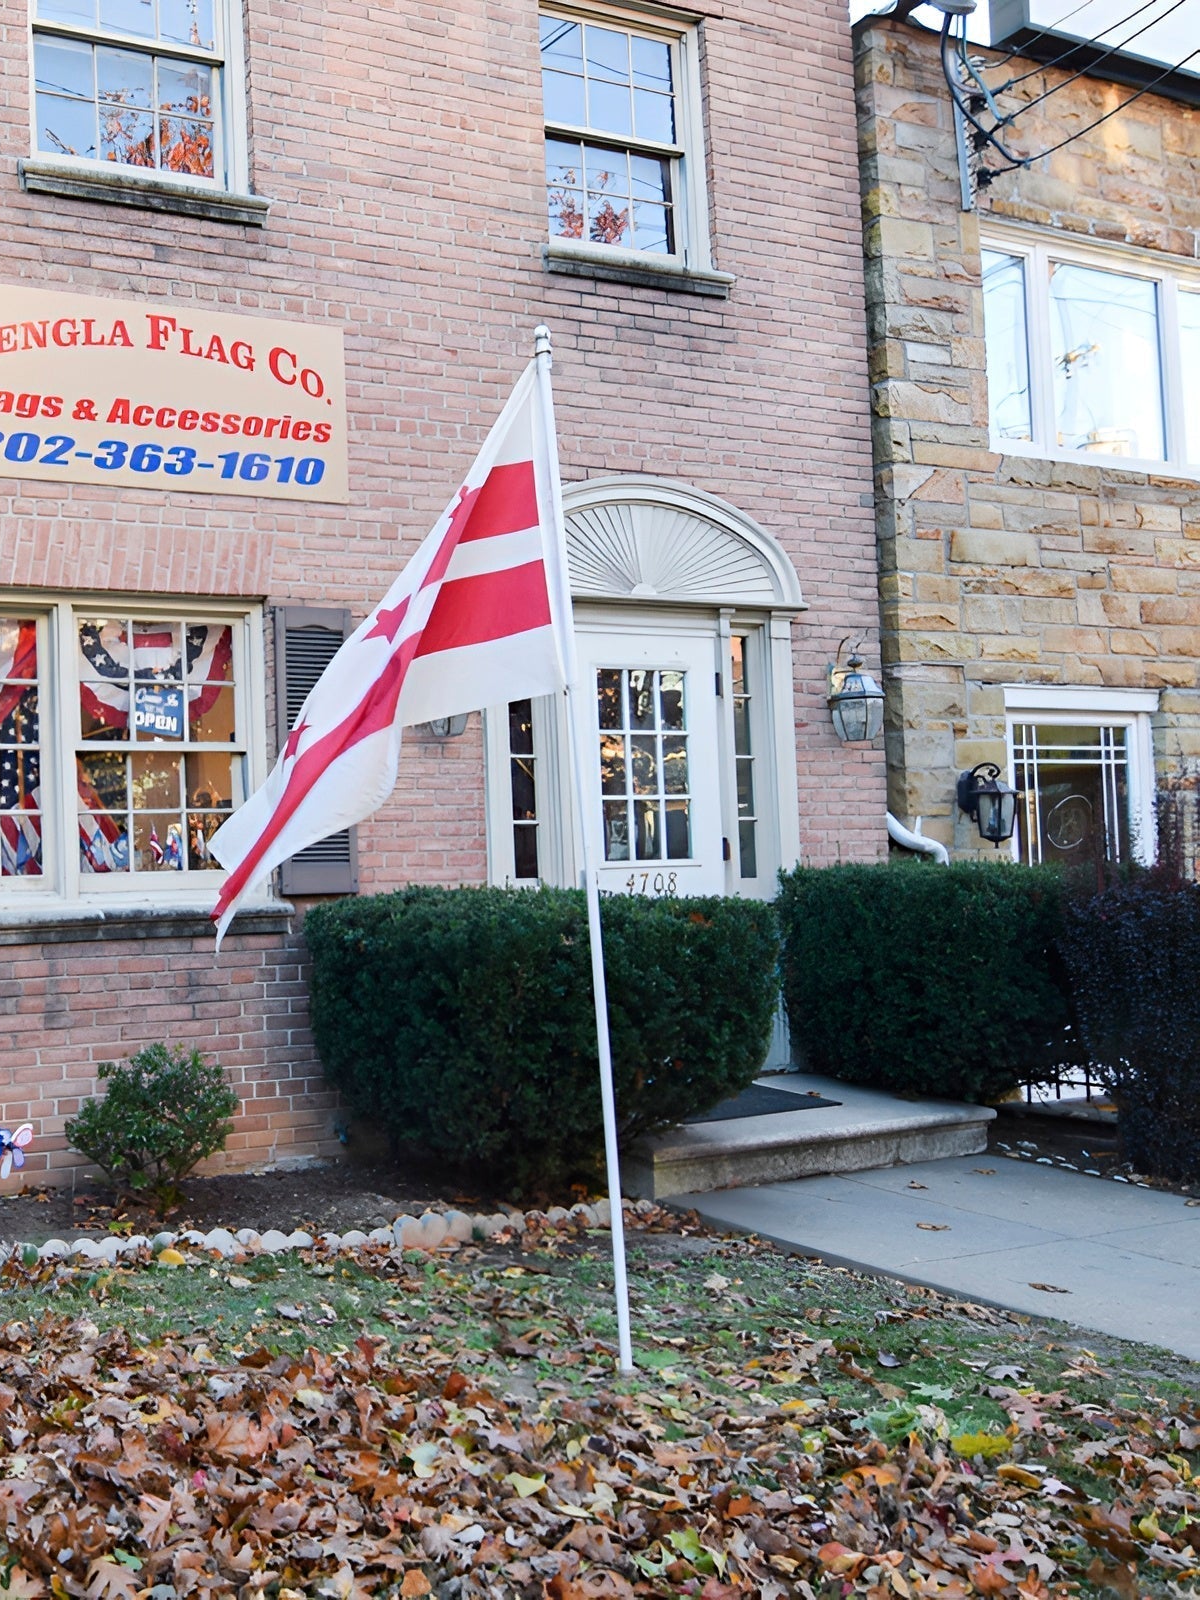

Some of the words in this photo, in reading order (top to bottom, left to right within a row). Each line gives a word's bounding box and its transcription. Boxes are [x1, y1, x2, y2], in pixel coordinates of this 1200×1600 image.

[146, 314, 255, 371] FLAG
[268, 346, 332, 405] CO.
[72, 398, 98, 422] &
[106, 398, 332, 443] Accessories
[135, 711, 177, 732] OPEN
[626, 872, 677, 894] 4708
